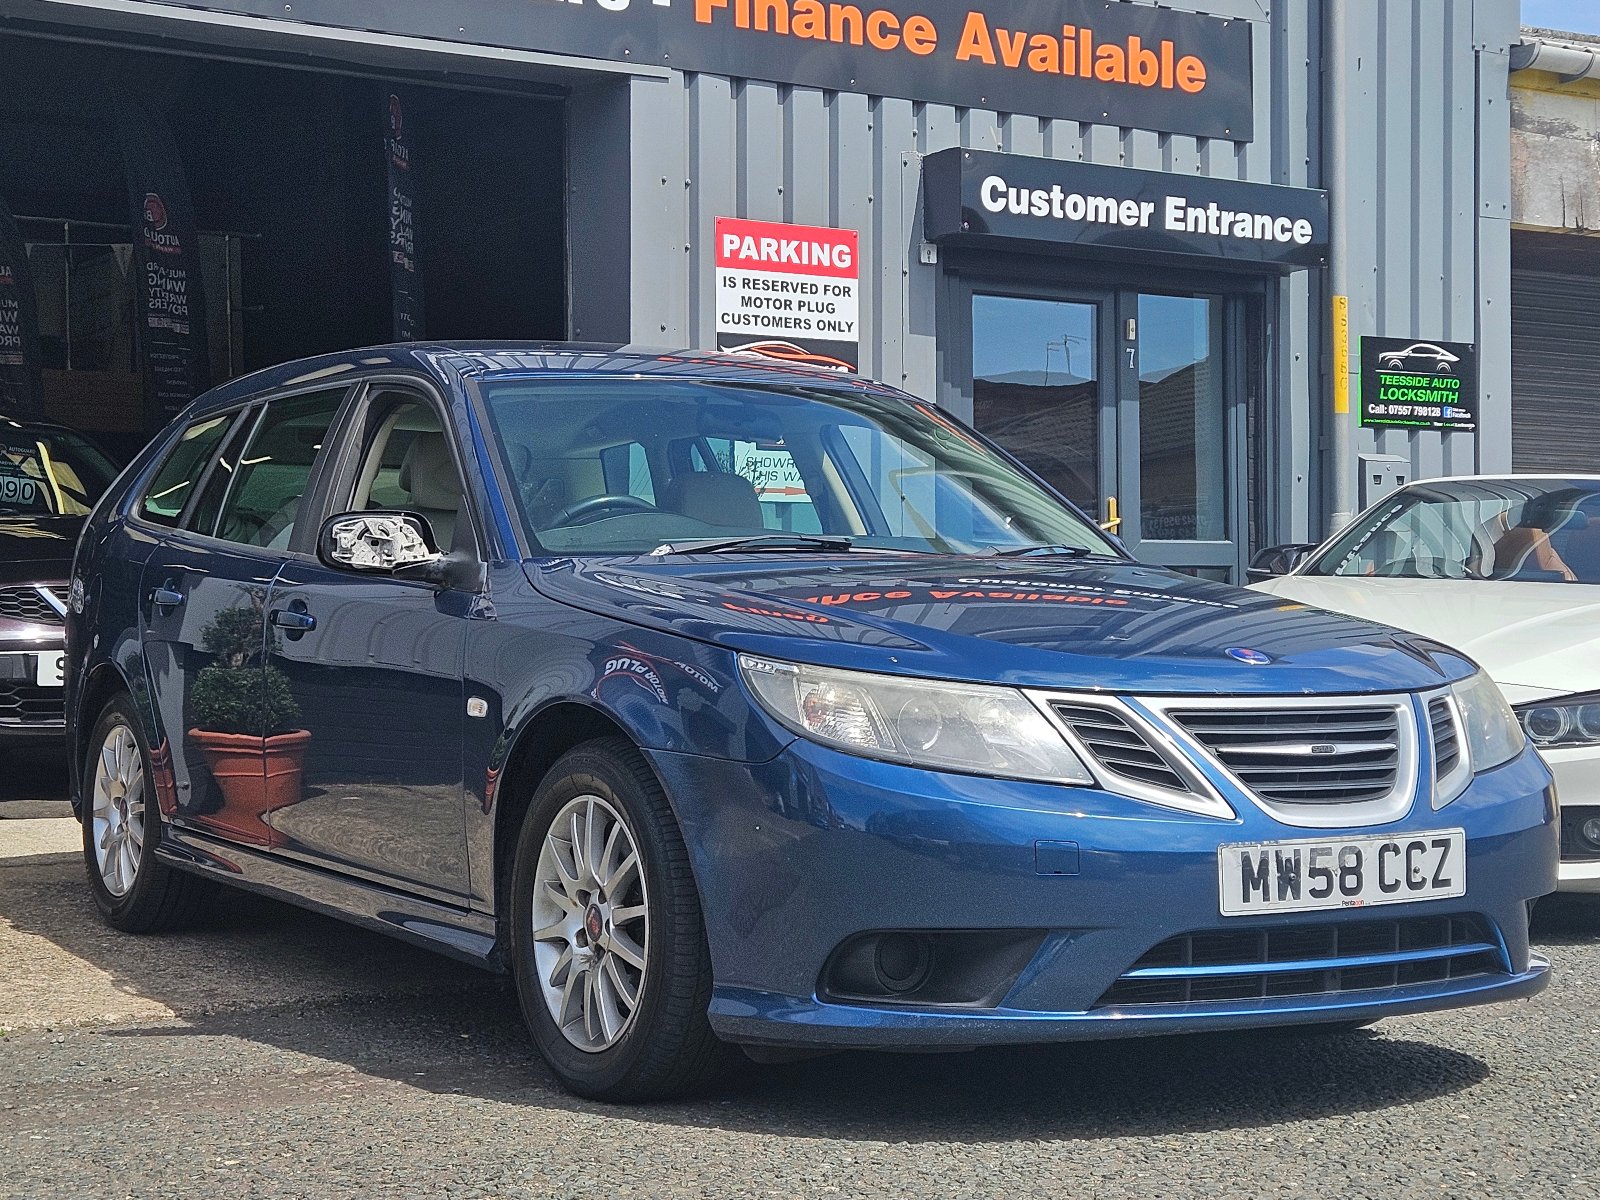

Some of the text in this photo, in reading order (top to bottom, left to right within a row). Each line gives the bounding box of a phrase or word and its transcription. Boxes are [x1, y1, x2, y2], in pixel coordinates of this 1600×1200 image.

[955, 11, 1207, 93] Available
[980, 175, 1313, 244] Customer Entrance
[723, 233, 852, 269] PARKING
[723, 276, 852, 298] IS RESERVED FOR
[740, 295, 836, 314] MOTOR PLUG
[721, 312, 855, 333] CUSTOMERS ONLY
[1126, 348, 1135, 369] 7
[1380, 374, 1460, 389] TEESSIDE AUTO
[1379, 387, 1459, 403] LOCKSMITH
[1368, 403, 1387, 415] Call:
[746, 456, 795, 468] SHOWR
[783, 471, 802, 482] W
[1240, 837, 1452, 904] MW58 CCZ
